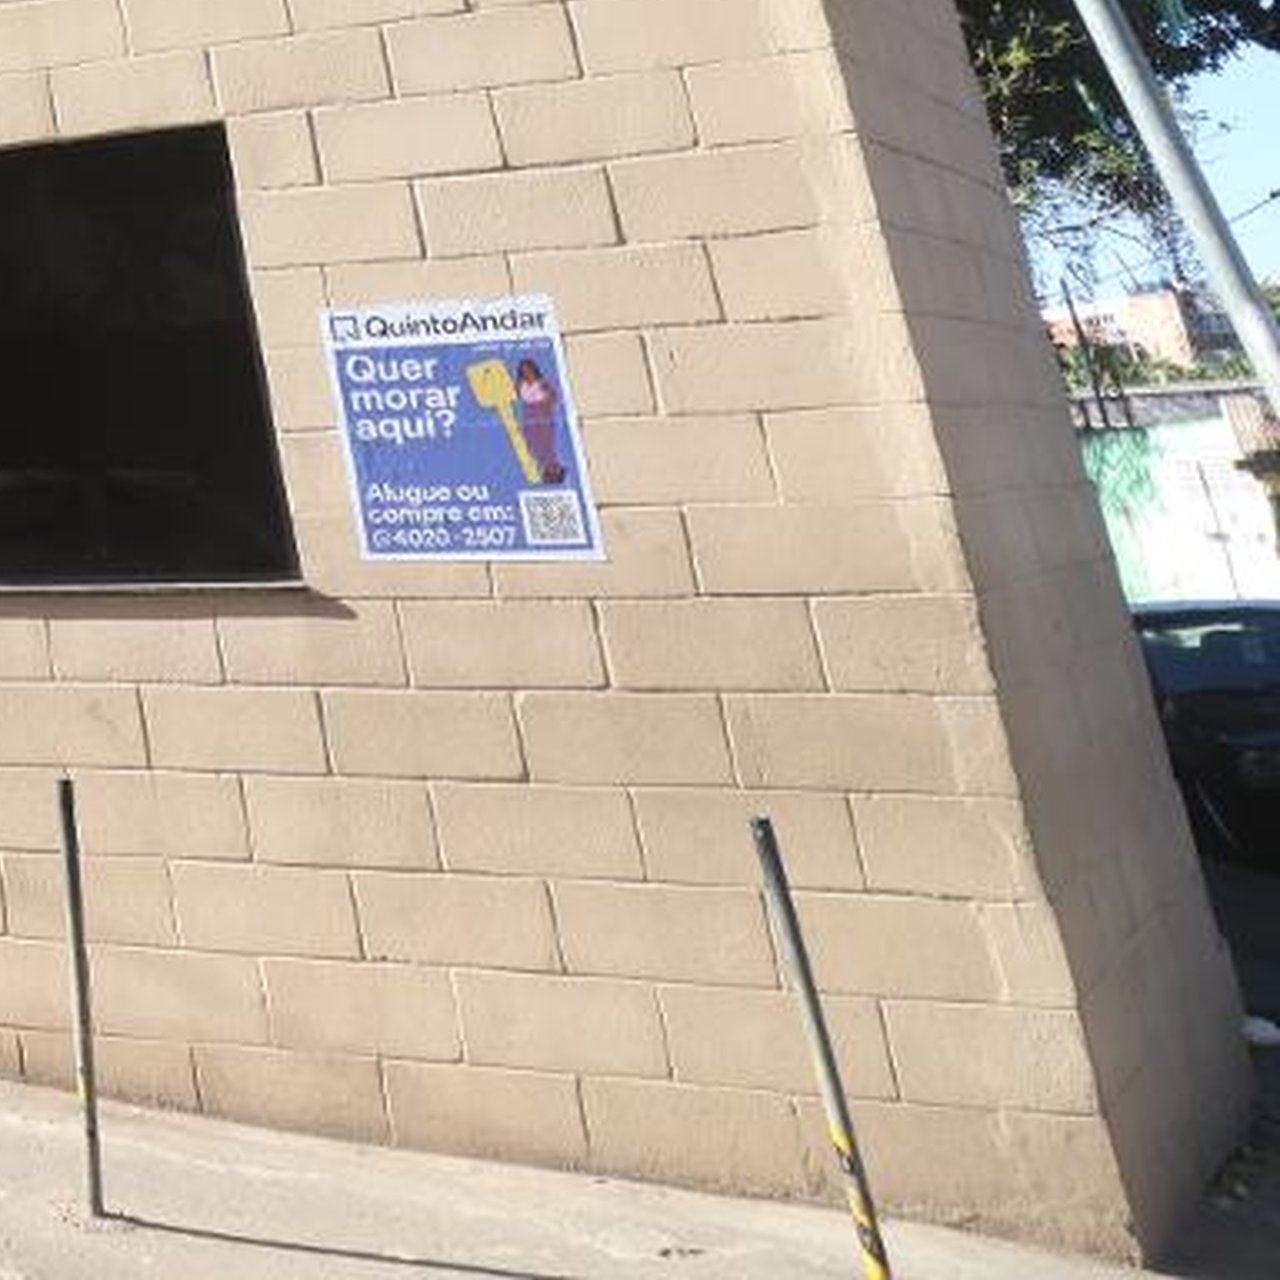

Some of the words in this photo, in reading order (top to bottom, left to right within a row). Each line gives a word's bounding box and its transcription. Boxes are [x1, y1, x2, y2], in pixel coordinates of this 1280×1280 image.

[365, 308, 547, 338] QuintoAndar
[345, 354, 438, 383] Quer
[351, 384, 461, 412] morar
[355, 409, 457, 444] aqui?
[367, 483, 451, 505] Alugue
[456, 484, 490, 501] ou
[368, 506, 462, 526] compre
[468, 505, 515, 521] em:
